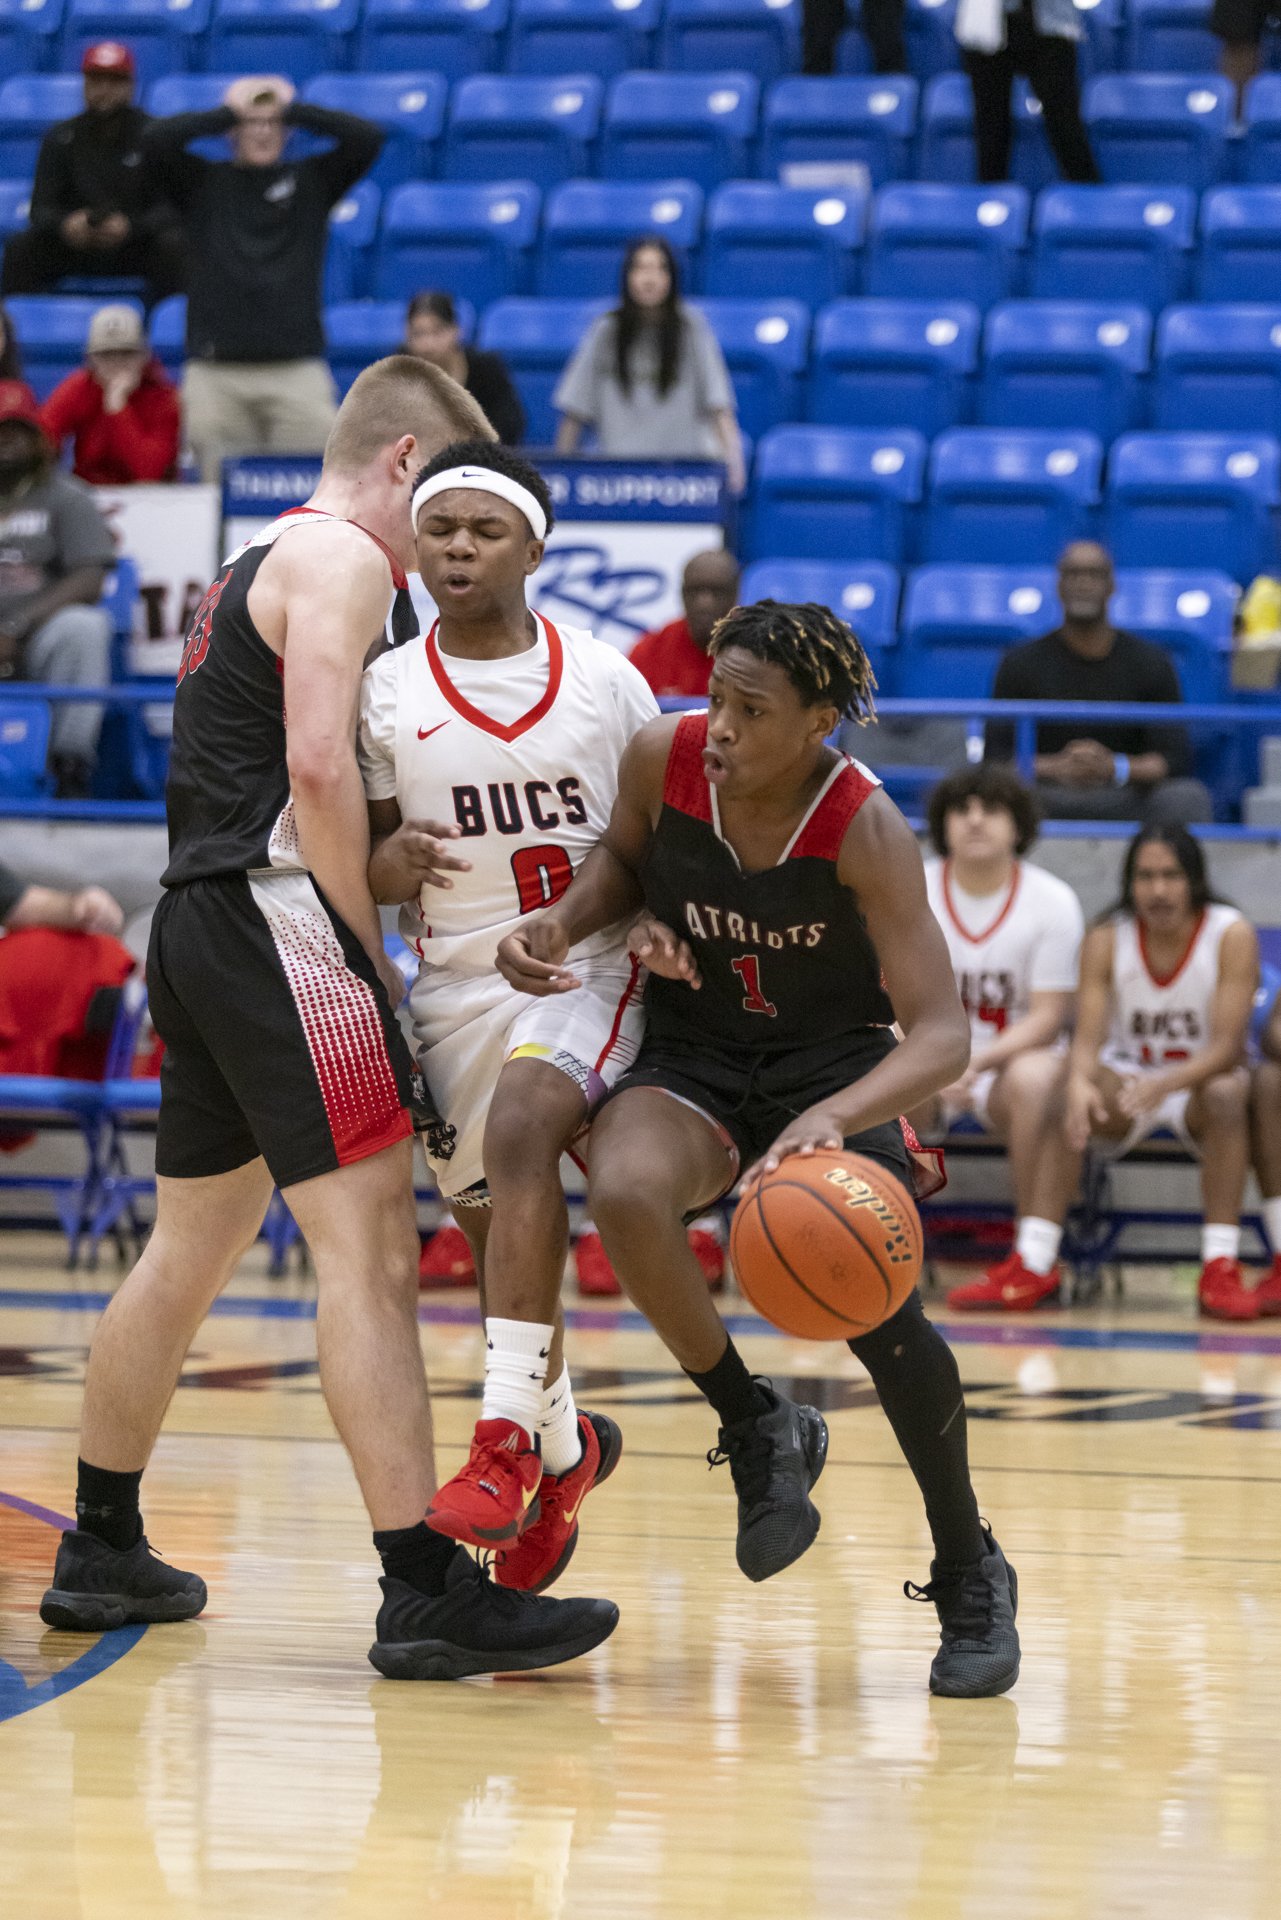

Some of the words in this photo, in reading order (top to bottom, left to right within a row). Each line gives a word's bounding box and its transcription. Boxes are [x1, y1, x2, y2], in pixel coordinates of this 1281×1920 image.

[575, 475, 721, 506] SUPPORT
[451, 777, 588, 837] BUCS
[510, 844, 574, 915] 0
[684, 902, 826, 949] ATRIOTS
[730, 954, 778, 1018] 1
[824, 1166, 912, 1264] Baden
